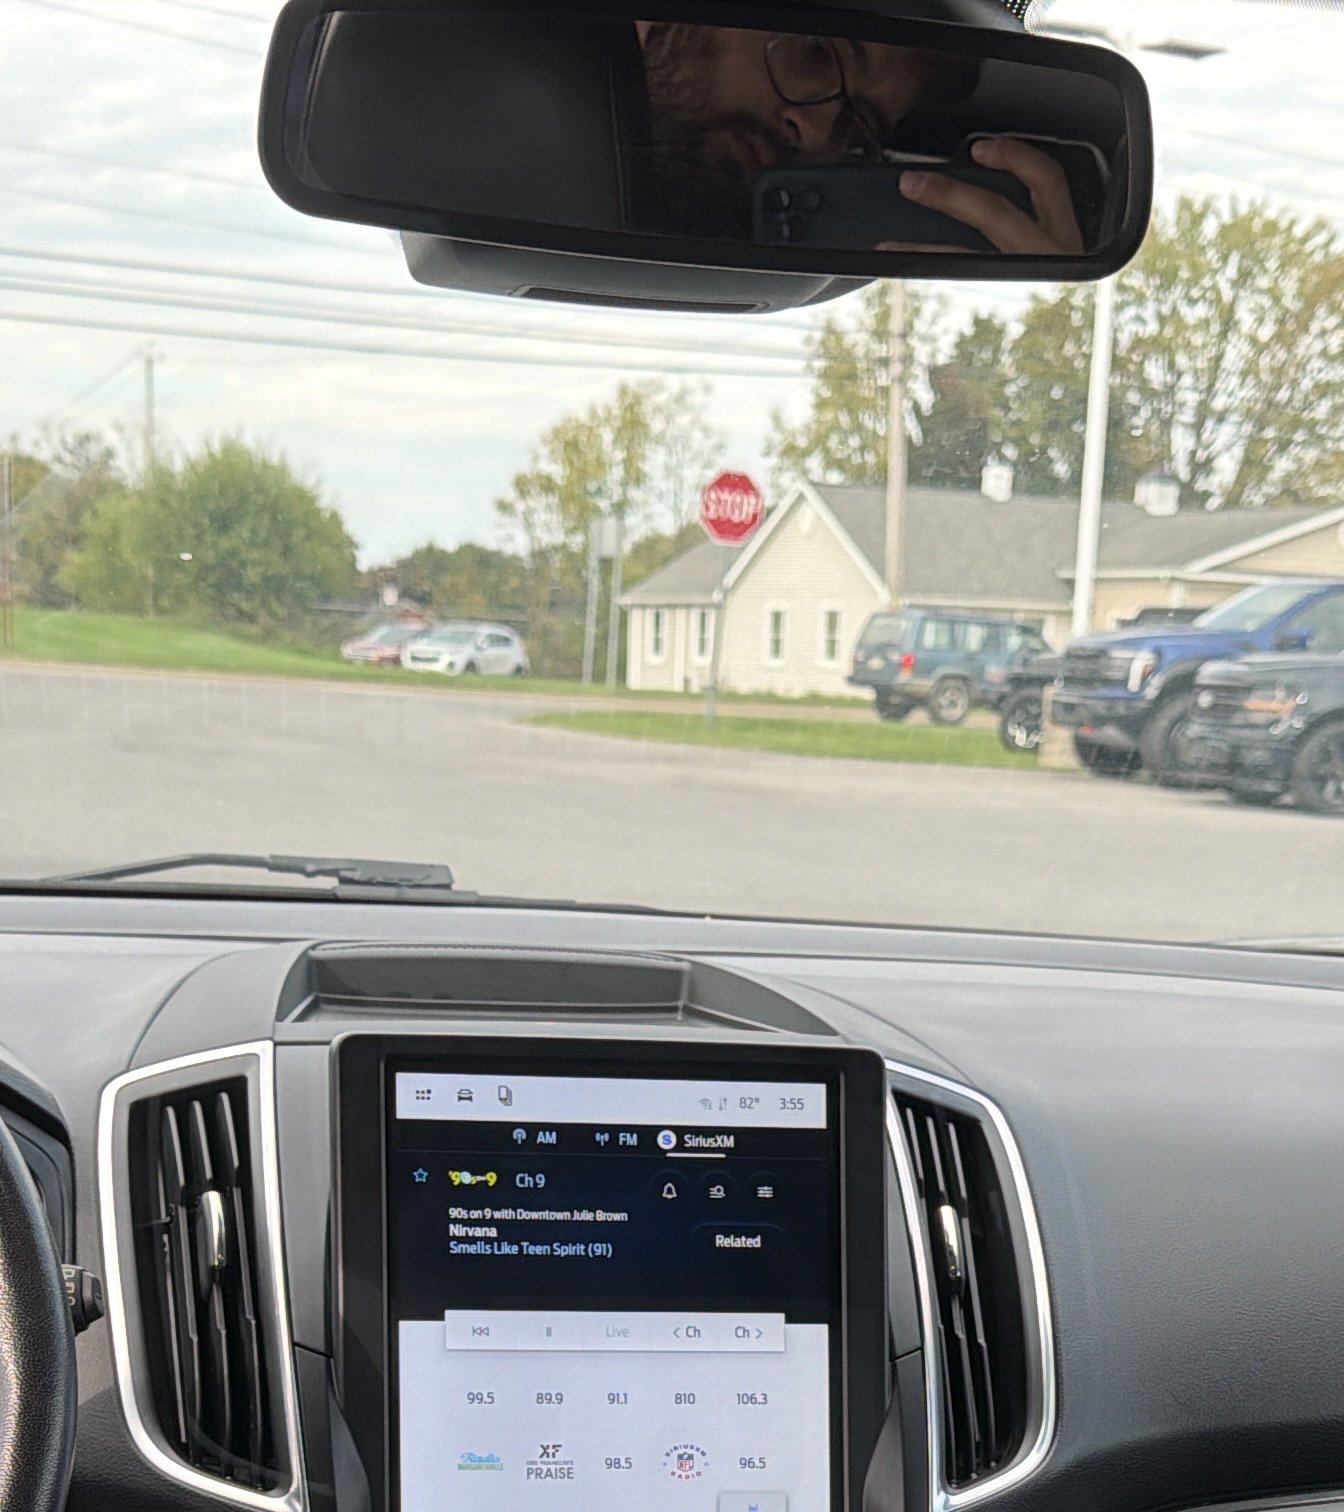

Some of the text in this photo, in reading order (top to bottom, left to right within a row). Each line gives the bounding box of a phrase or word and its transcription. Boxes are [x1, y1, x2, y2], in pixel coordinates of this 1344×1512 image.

[705, 488, 758, 524] STOP
[738, 1096, 760, 1110] 82°
[779, 1098, 805, 1111] 3:55
[536, 1131, 556, 1145] AM
[618, 1133, 638, 1146] FM
[683, 1134, 735, 1148] SiriusXM
[515, 1173, 546, 1188] Ch 9
[448, 1208, 629, 1222] 90s on 9 with Downtown Julie Brown
[449, 1224, 498, 1238] Nirvana
[715, 1234, 762, 1249] Related
[449, 1241, 613, 1259] Smells Like Teen Spirit (91)
[684, 1326, 702, 1339] Ch
[734, 1326, 751, 1339] Ch
[466, 1391, 495, 1406] 99.5
[535, 1392, 564, 1405] 89.9
[606, 1392, 629, 1405] 91.1
[673, 1392, 696, 1406] 810
[735, 1392, 769, 1407] 106.3
[604, 1457, 633, 1470] 98.5
[738, 1457, 767, 1470] 96.5
[526, 1467, 575, 1480] PRAISE
